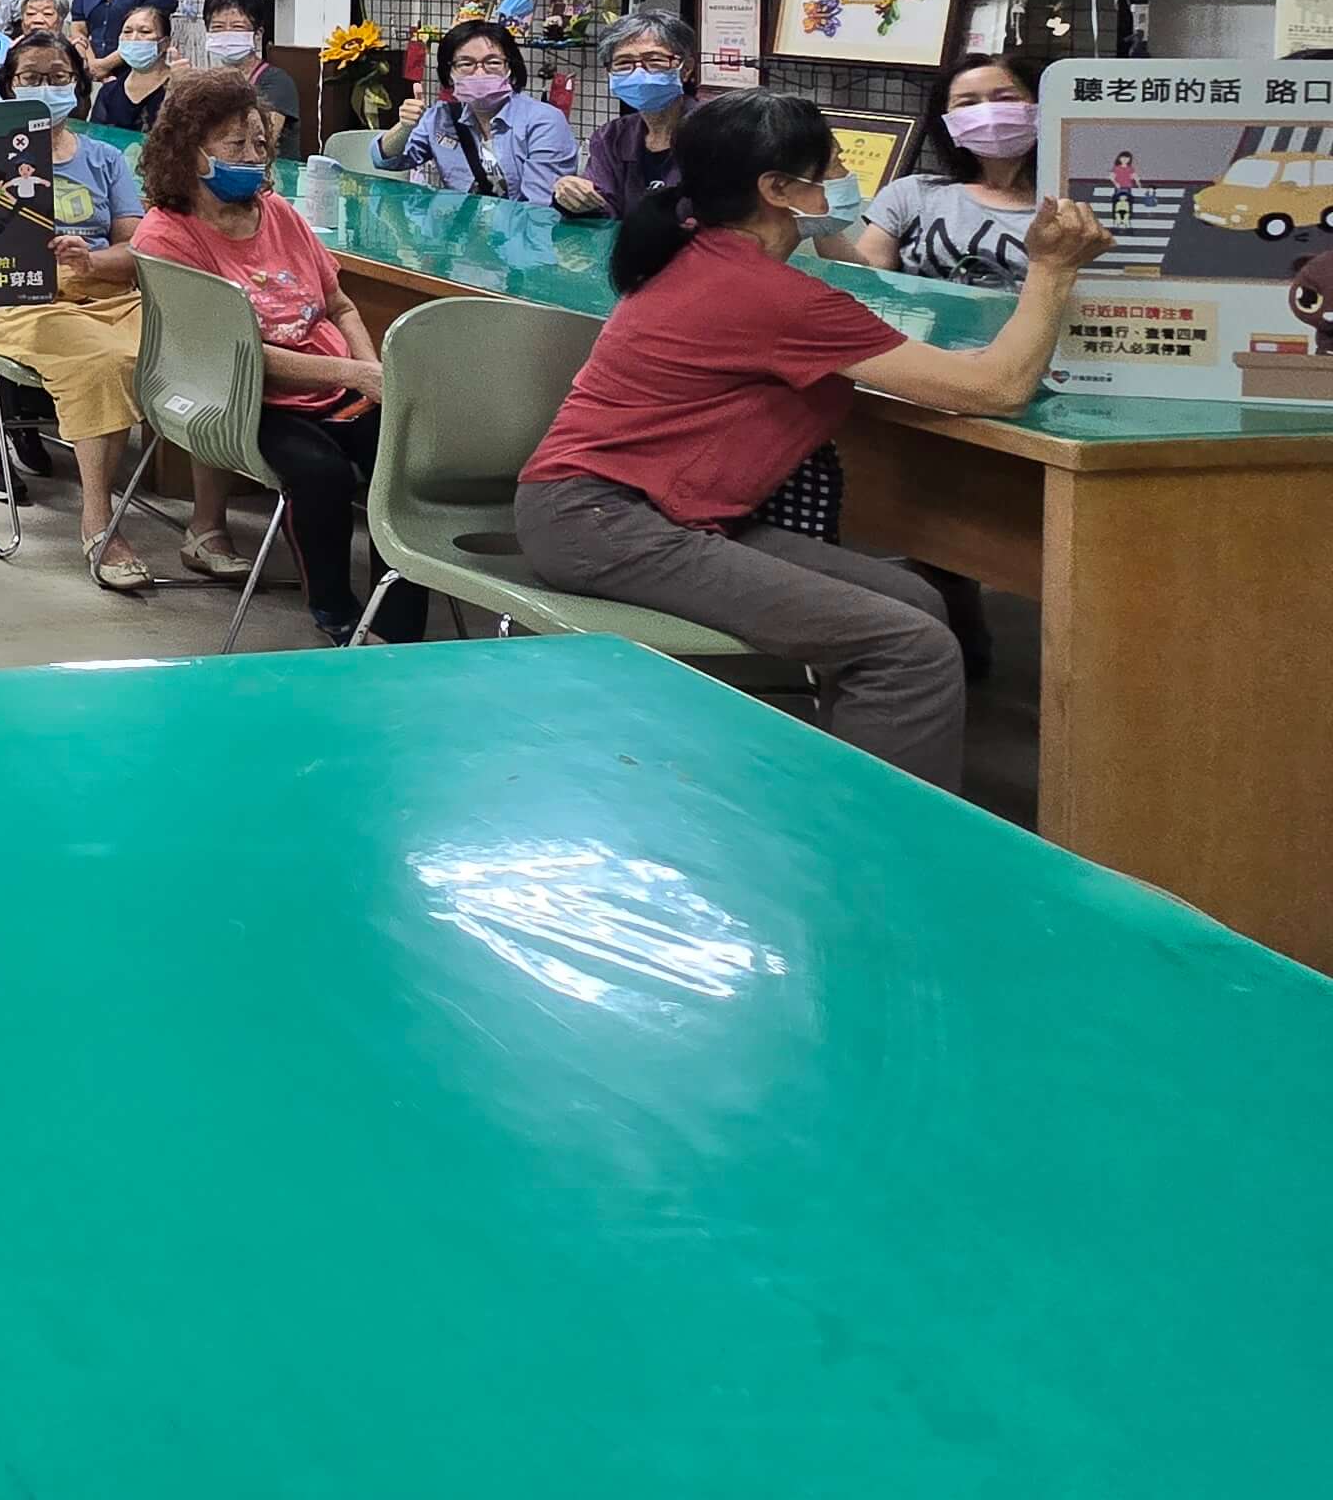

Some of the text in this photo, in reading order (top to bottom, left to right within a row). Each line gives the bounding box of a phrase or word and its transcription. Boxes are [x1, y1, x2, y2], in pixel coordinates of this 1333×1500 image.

[1073, 77, 1332, 104] 聽老師的話 路口
[1080, 303, 1194, 321] 行近路口請注意
